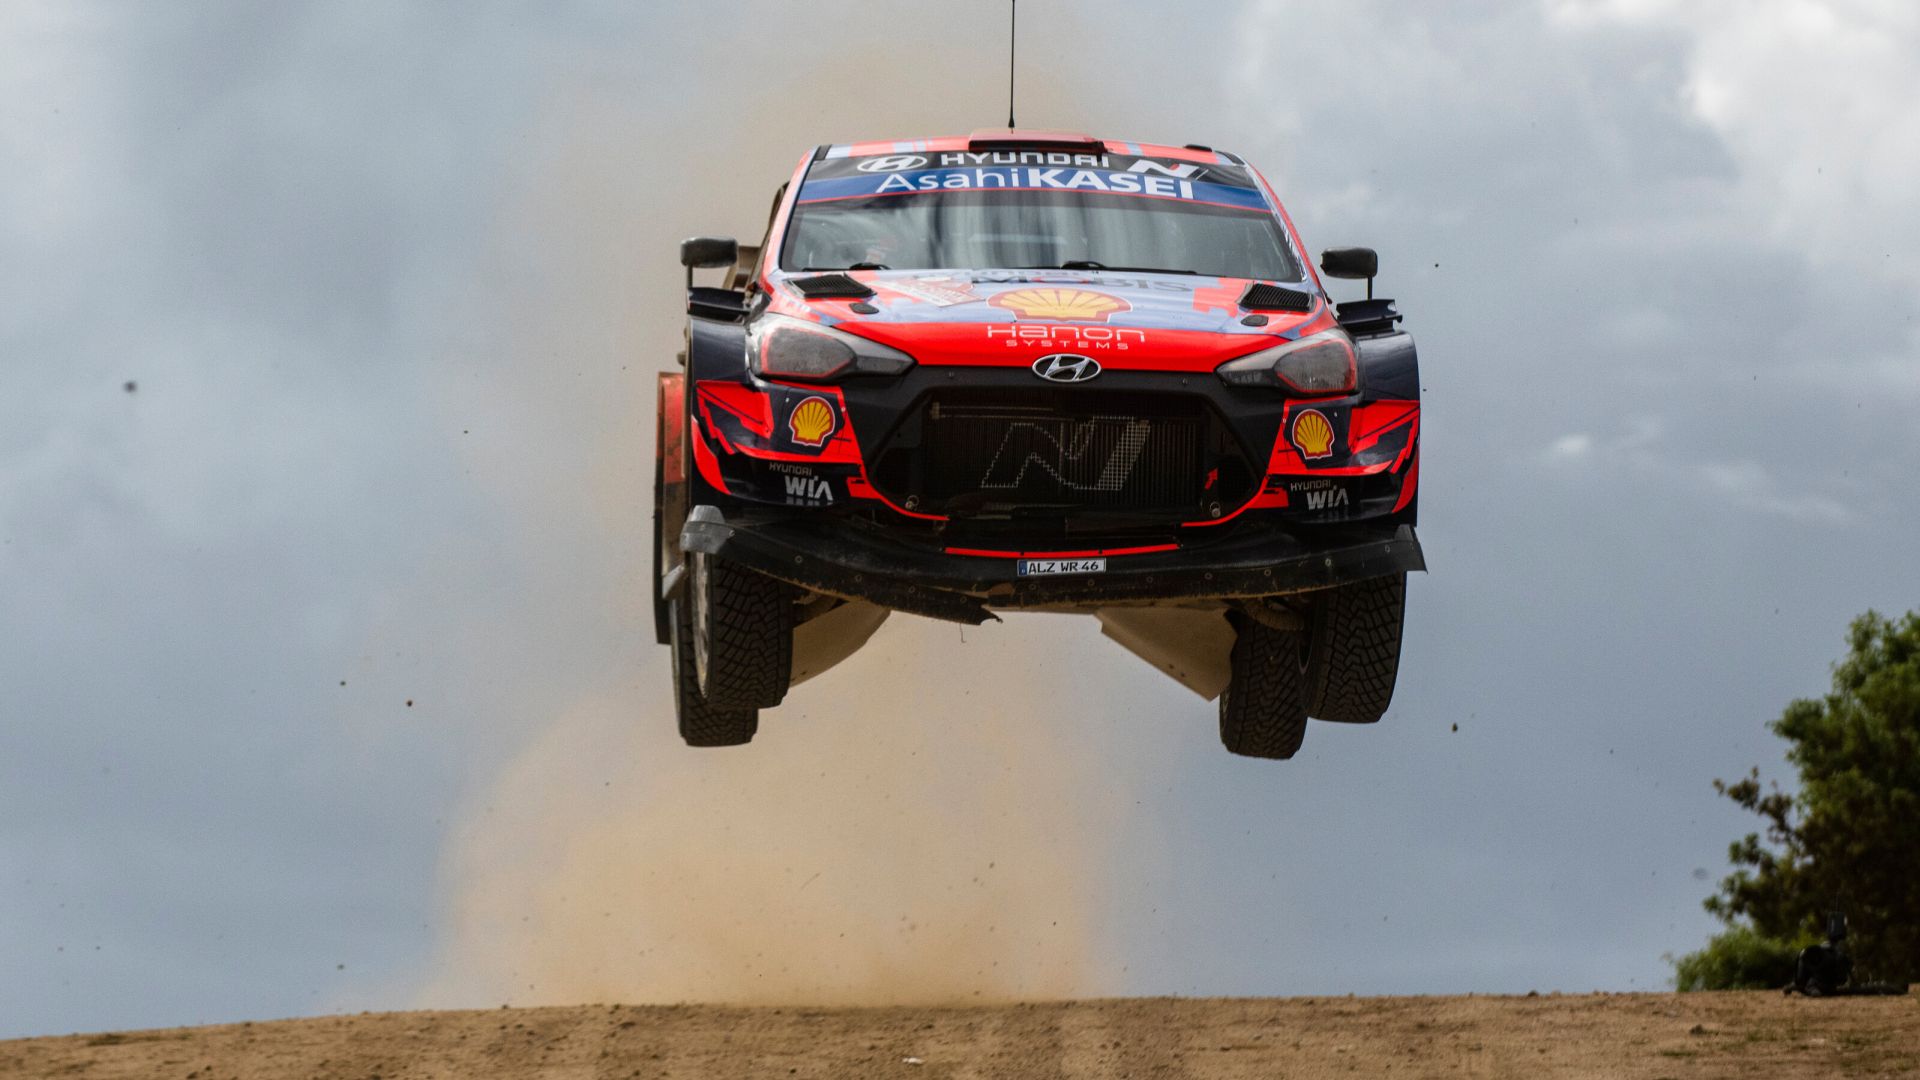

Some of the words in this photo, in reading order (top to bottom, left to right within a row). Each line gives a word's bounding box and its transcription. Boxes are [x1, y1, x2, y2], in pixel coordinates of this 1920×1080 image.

[941, 152, 1110, 168] HYUNDAI
[1006, 340, 1129, 350] SYSTEMS
[769, 462, 813, 476] HYUNDAI
[784, 475, 834, 501] WIA
[1290, 479, 1331, 492] HYUNDAI
[1306, 484, 1349, 510] WIA
[1028, 562, 1056, 574] ALZ
[1061, 562, 1079, 572] WR
[1081, 561, 1099, 571] 46
